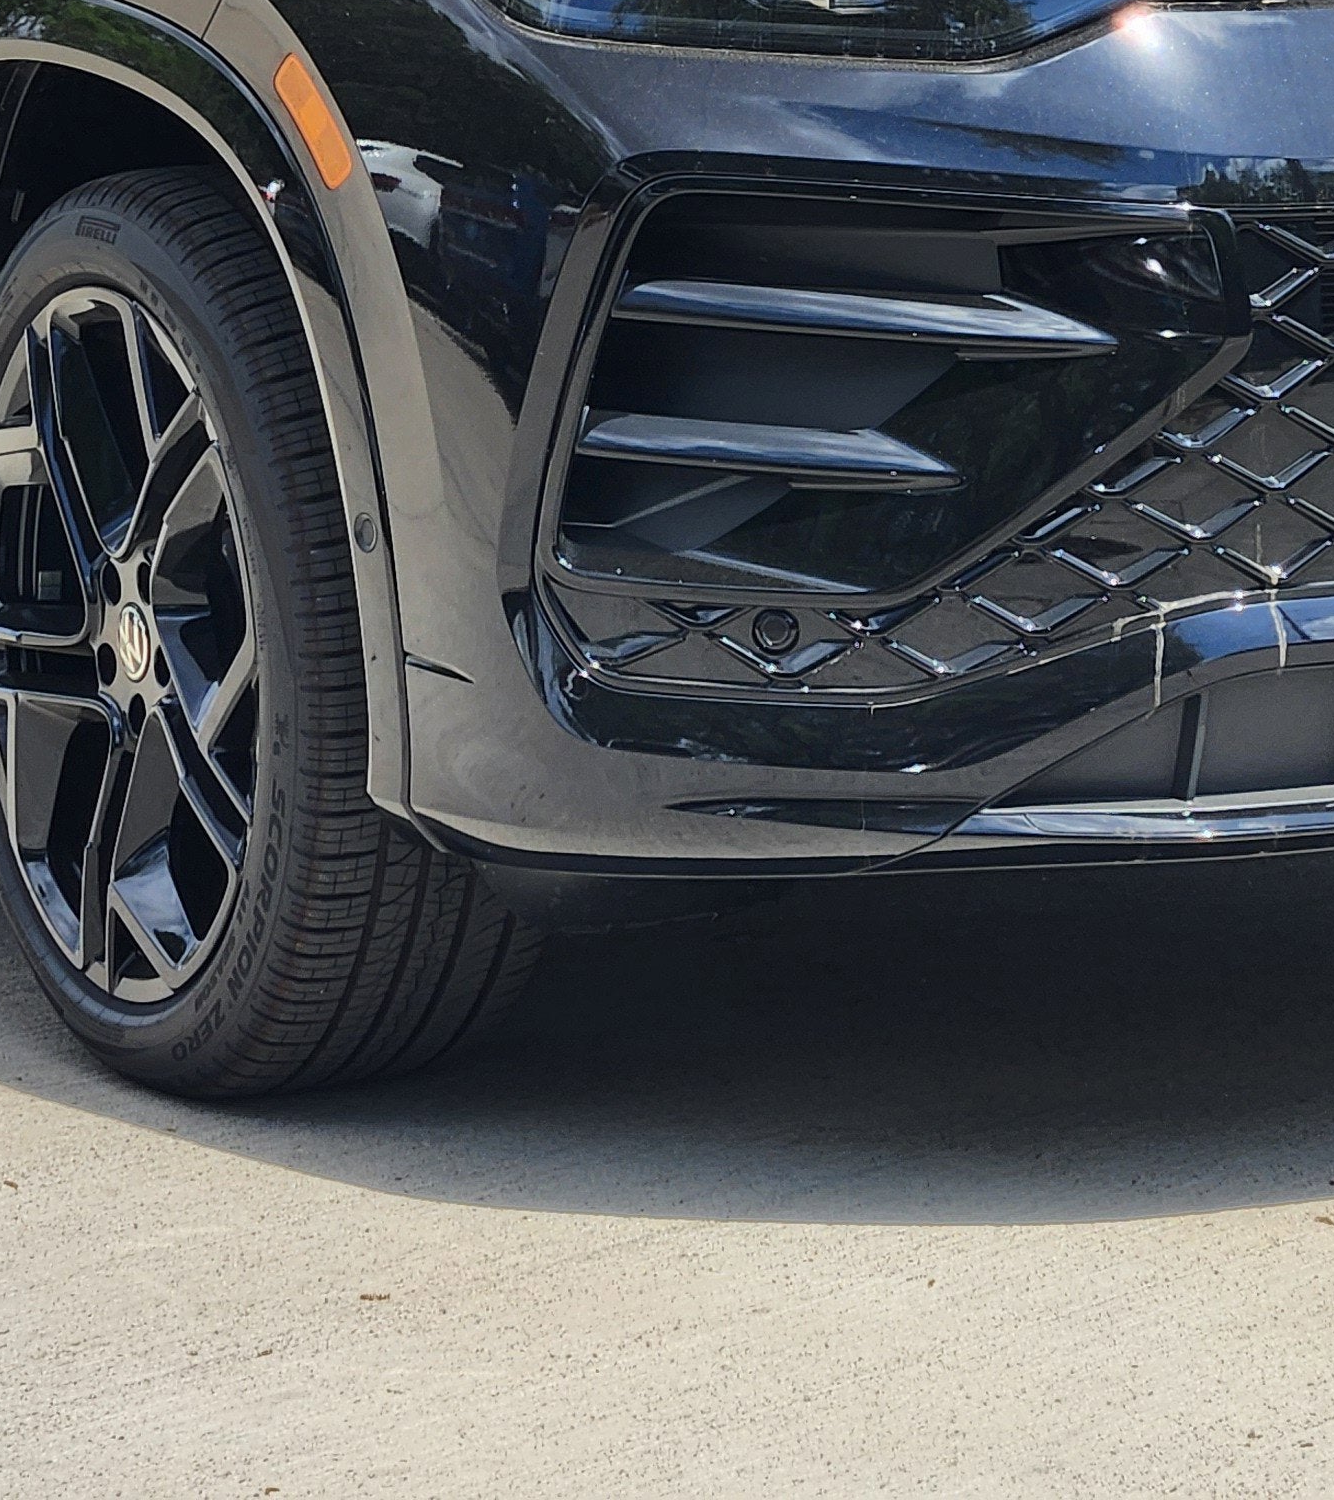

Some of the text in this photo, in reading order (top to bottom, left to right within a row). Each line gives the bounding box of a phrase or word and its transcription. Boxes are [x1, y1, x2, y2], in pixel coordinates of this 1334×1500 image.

[75, 215, 121, 246] PIRELLI
[171, 777, 287, 1062] SCORPION ZERO
